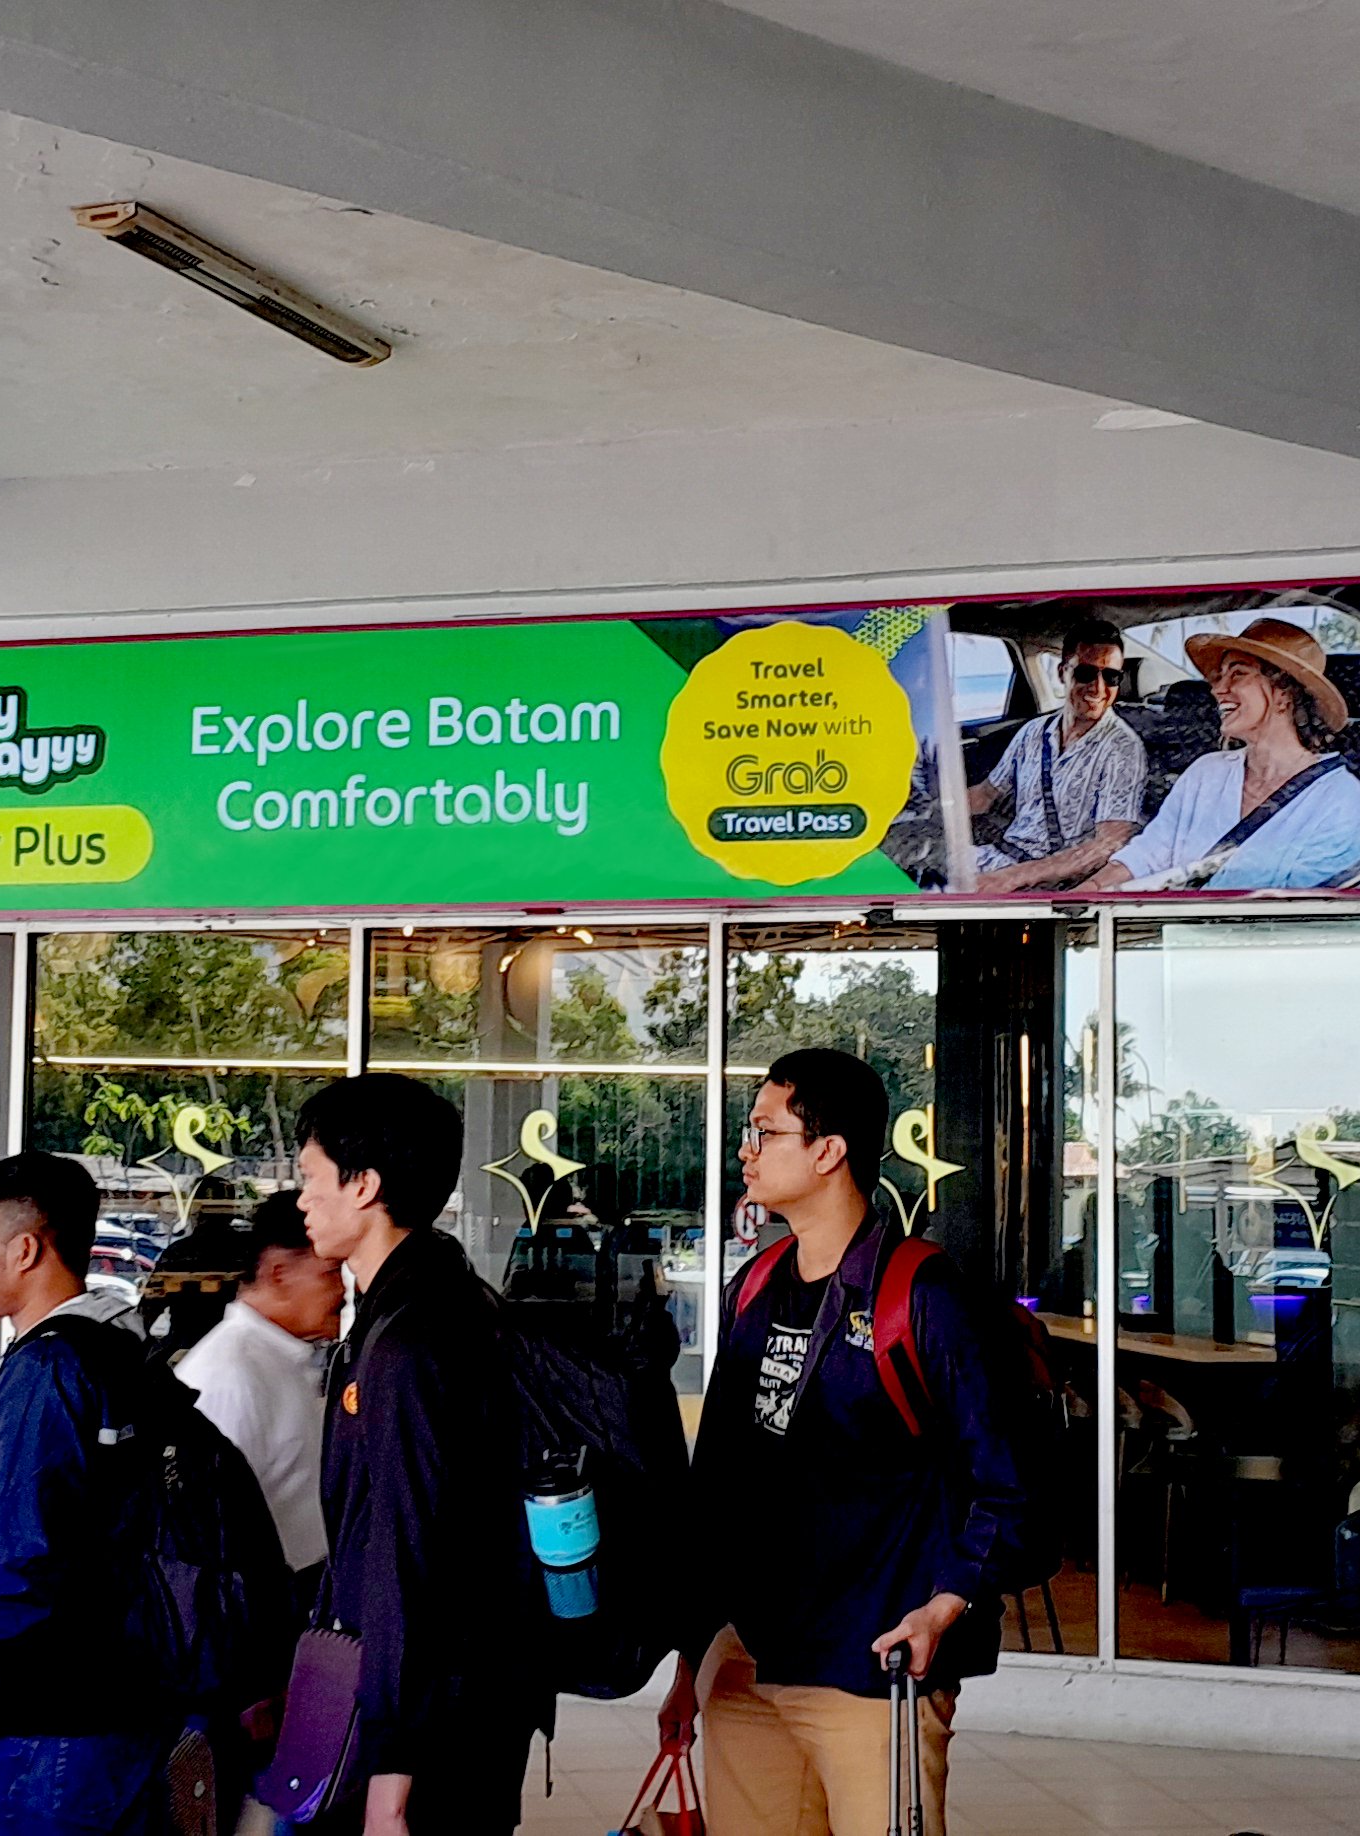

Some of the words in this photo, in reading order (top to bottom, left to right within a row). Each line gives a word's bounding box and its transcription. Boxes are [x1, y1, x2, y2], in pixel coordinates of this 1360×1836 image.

[750, 657, 825, 680] Travel
[736, 690, 838, 710] Smarter,
[190, 698, 411, 767] Explore
[427, 696, 621, 747] Batam
[703, 720, 760, 740] Save
[766, 718, 818, 738] Now
[823, 714, 872, 736] with
[726, 748, 848, 796] Grab
[215, 767, 589, 837] Comfortably
[721, 810, 795, 834] Travel
[797, 811, 853, 832] Pass
[13, 823, 107, 867] Plus
